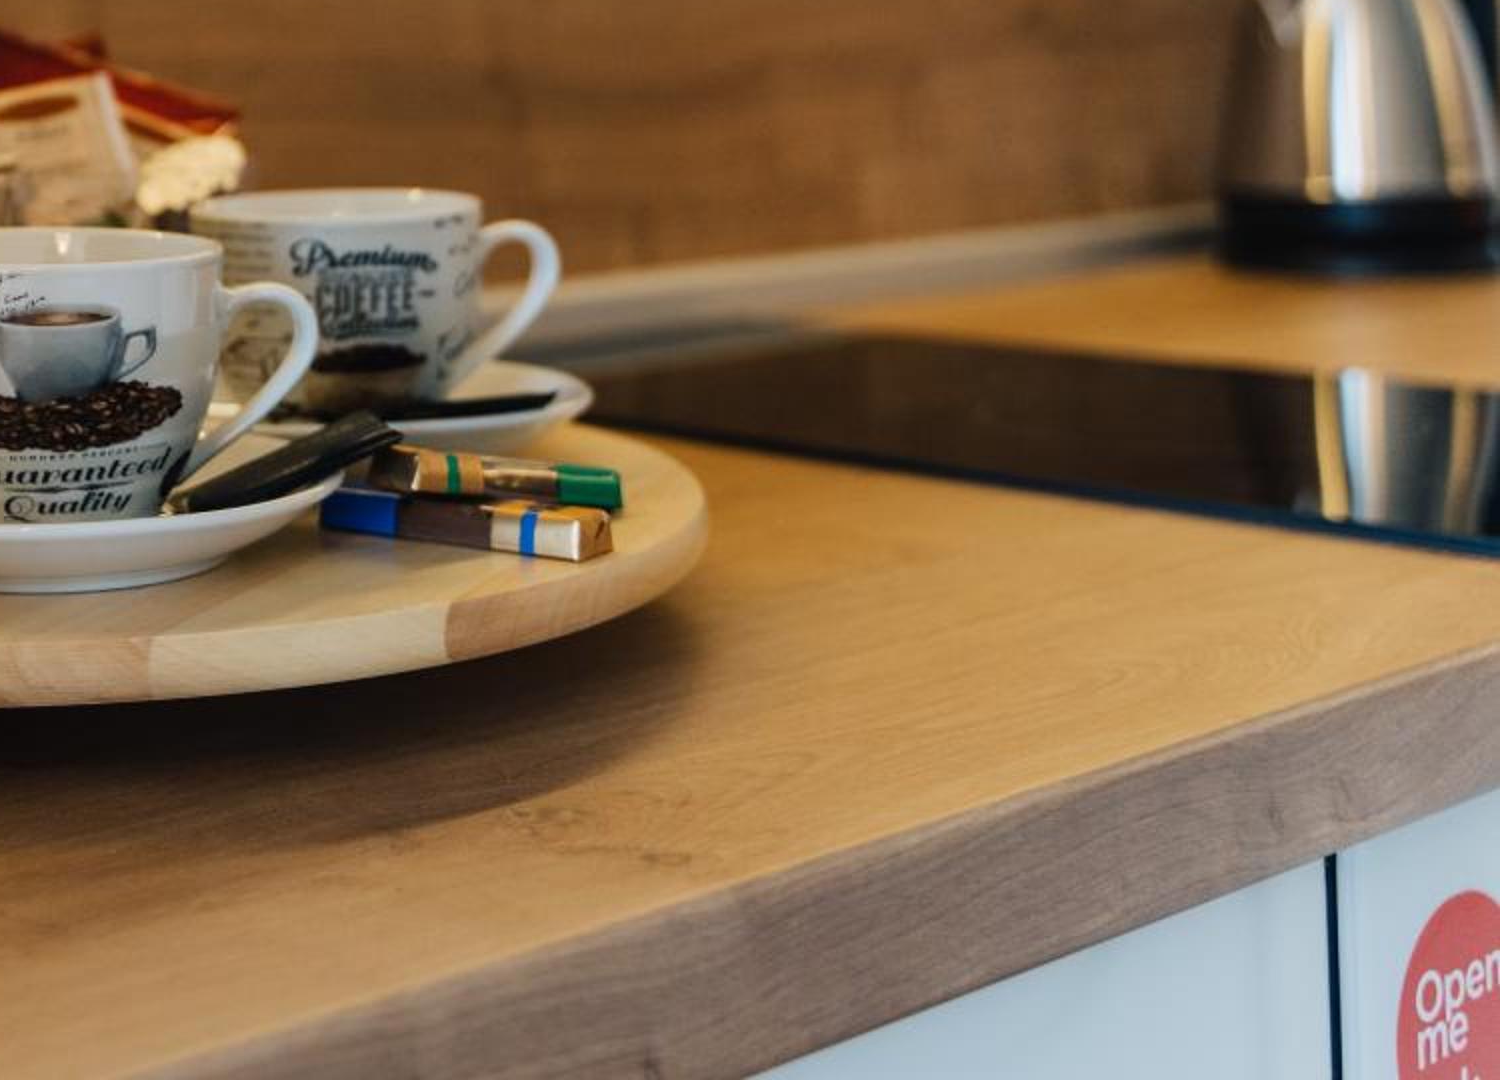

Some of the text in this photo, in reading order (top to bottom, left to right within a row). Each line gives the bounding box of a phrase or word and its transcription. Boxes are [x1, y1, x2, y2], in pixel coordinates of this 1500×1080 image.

[289, 238, 438, 276] Premium
[316, 274, 415, 312] COFFEE
[4, 491, 133, 523] Quality
[1415, 949, 1500, 1023] Open
[1417, 1011, 1469, 1071] me
